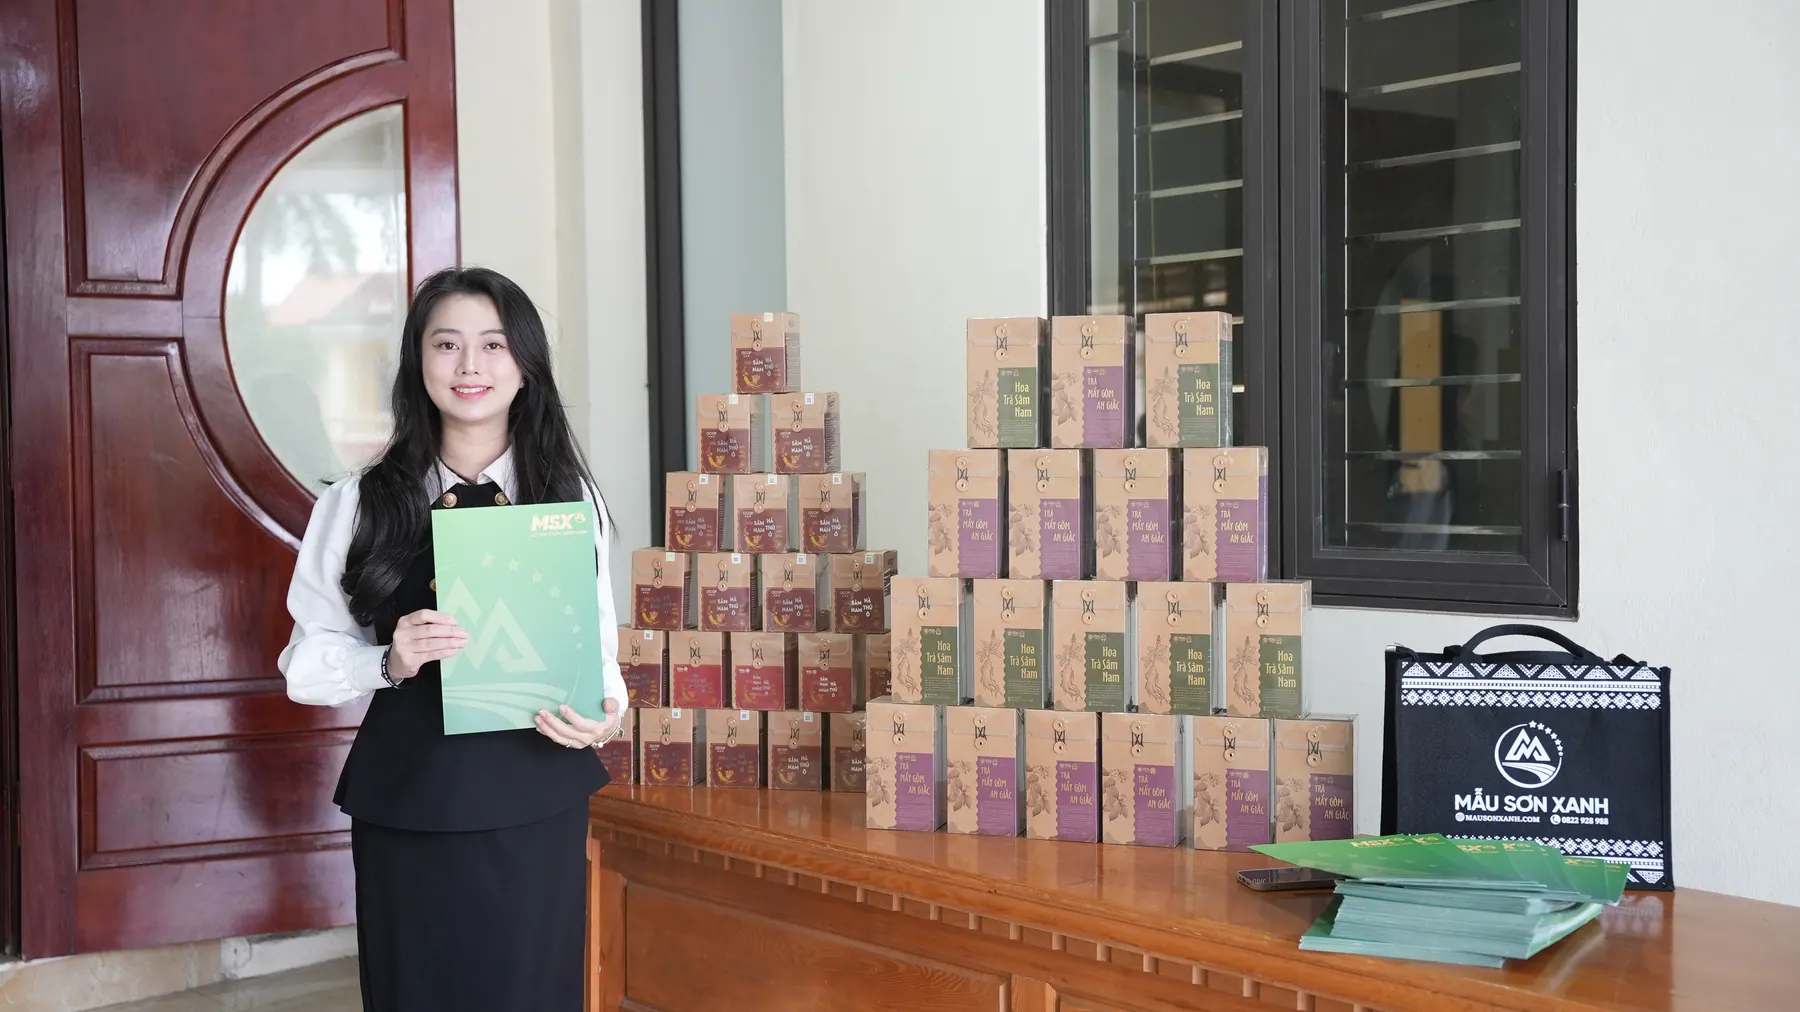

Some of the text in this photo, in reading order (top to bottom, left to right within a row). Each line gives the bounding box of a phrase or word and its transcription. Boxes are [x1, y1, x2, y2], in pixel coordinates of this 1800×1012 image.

[1088, 377, 1097, 386] TRÀ
[1196, 379, 1211, 390] Hoa
[1015, 382, 1029, 393] Hoa
[1004, 393, 1030, 405] Trà Sâm
[1184, 391, 1212, 403] Trà Sâm
[1096, 401, 1105, 410] AN
[1196, 404, 1214, 416] Nam
[1014, 406, 1032, 418] Nam
[962, 509, 973, 518] TRÀ
[1044, 509, 1053, 518] TRÀ
[1132, 510, 1142, 518] TRÀ
[1221, 509, 1231, 518] TRÀ
[531, 514, 574, 531] MSX
[971, 532, 979, 540] AN
[1053, 533, 1061, 542] AN
[1141, 534, 1149, 543] AN
[1230, 534, 1238, 543] AN
[937, 641, 951, 651] Hoa
[1021, 643, 1035, 654] Hoa
[1103, 646, 1117, 657] Hoa
[1188, 648, 1203, 660] Hoa
[1277, 651, 1292, 661] Hoa
[926, 652, 952, 663] Trà Sâm
[1010, 655, 1036, 667] Trà Sâm
[1091, 658, 1118, 670] Trà Sâm
[1176, 661, 1204, 673] Trà Sâm
[1265, 663, 1294, 674] Trà Sâm
[937, 665, 953, 675] Nam
[1021, 668, 1038, 679] Nam
[1103, 671, 1120, 682] Nam
[1188, 674, 1205, 685] Nam
[1278, 676, 1296, 687] Nam
[981, 767, 990, 775] TRÀ
[1060, 771, 1070, 780] TRÀ
[1138, 775, 1148, 784] TRÀ
[1231, 780, 1241, 788] TRÀ
[908, 786, 917, 794] AN
[1315, 784, 1325, 793] TRÀ
[990, 790, 998, 799] AN
[1069, 795, 1079, 804] AN
[1148, 800, 1156, 808] AN
[1455, 788, 1609, 814] MẪU SƠN XANH
[1240, 805, 1249, 814] AN
[1324, 810, 1334, 819] AN
[1465, 815, 1540, 823] MAUSONXANH.COM
